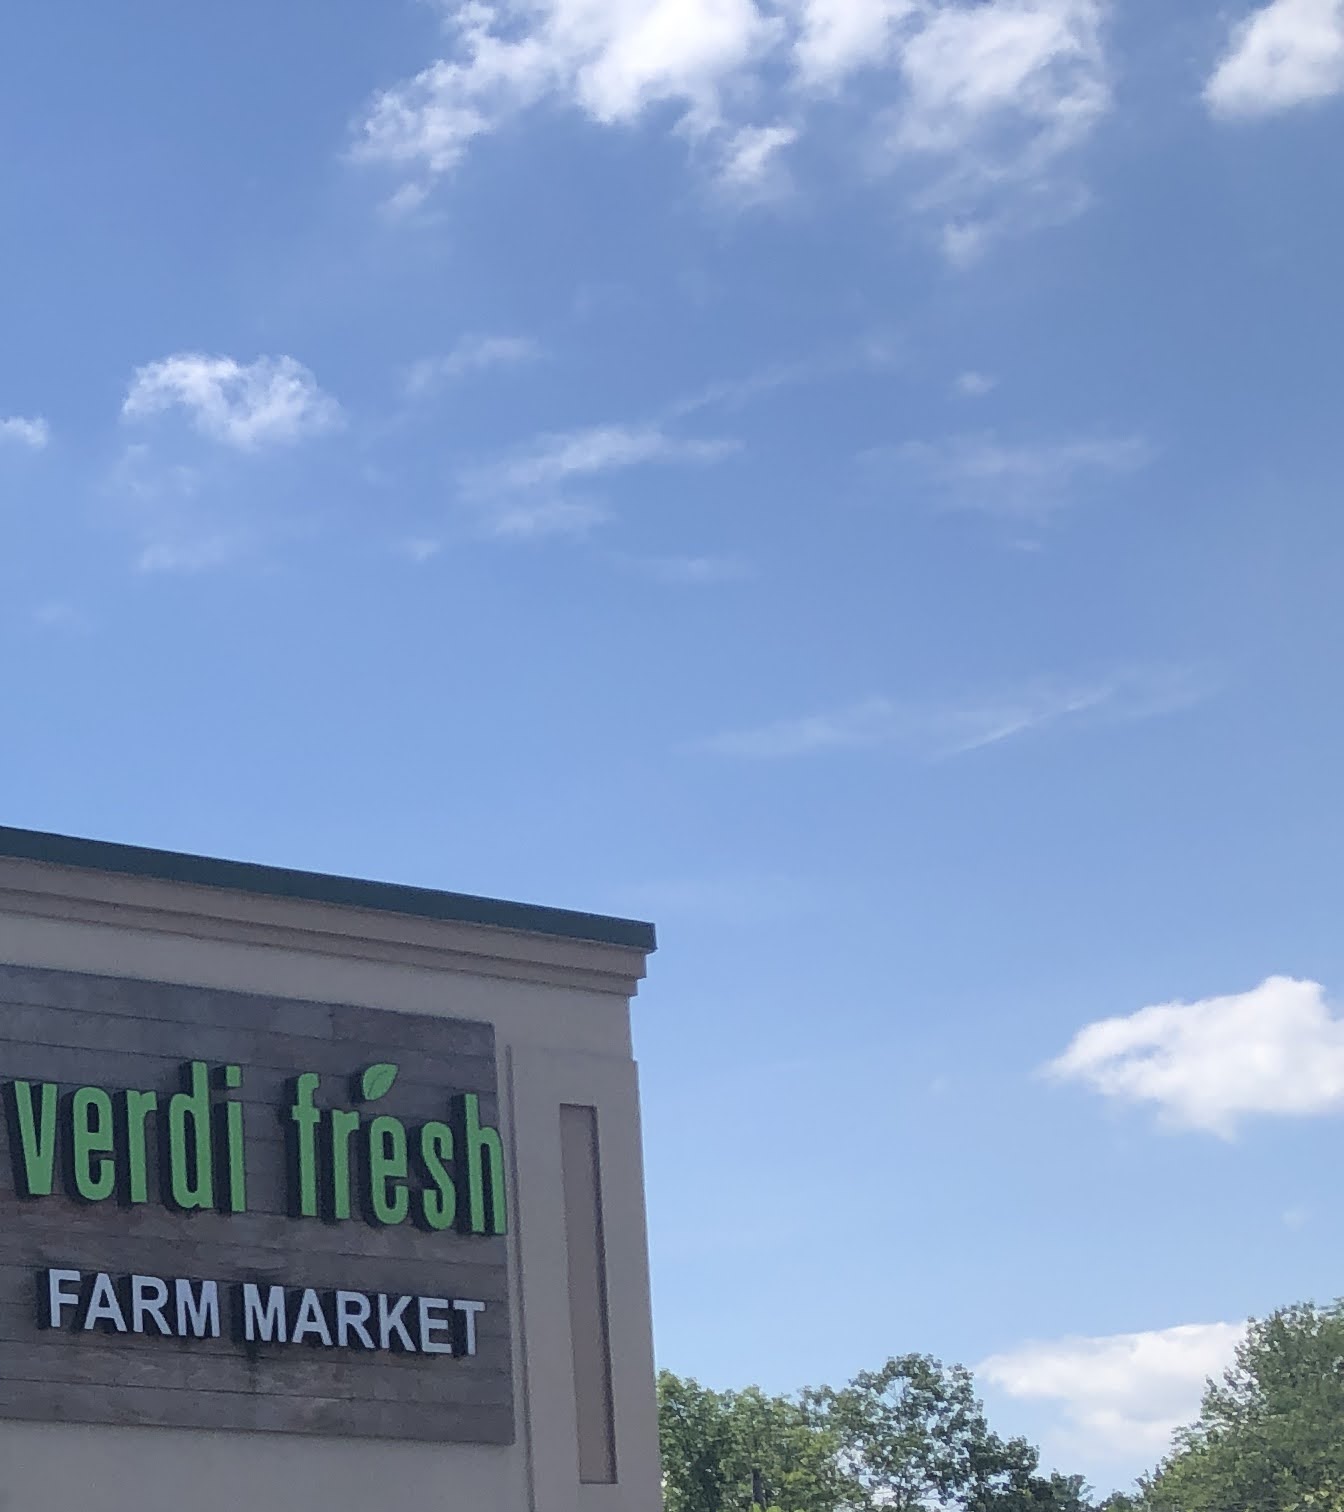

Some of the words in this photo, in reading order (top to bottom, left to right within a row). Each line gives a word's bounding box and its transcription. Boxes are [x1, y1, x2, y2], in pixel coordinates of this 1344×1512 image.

[14, 1061, 247, 1213] verdi
[292, 1068, 508, 1236] fresh
[48, 1268, 221, 1338] FARM
[243, 1283, 486, 1356] MARKET
